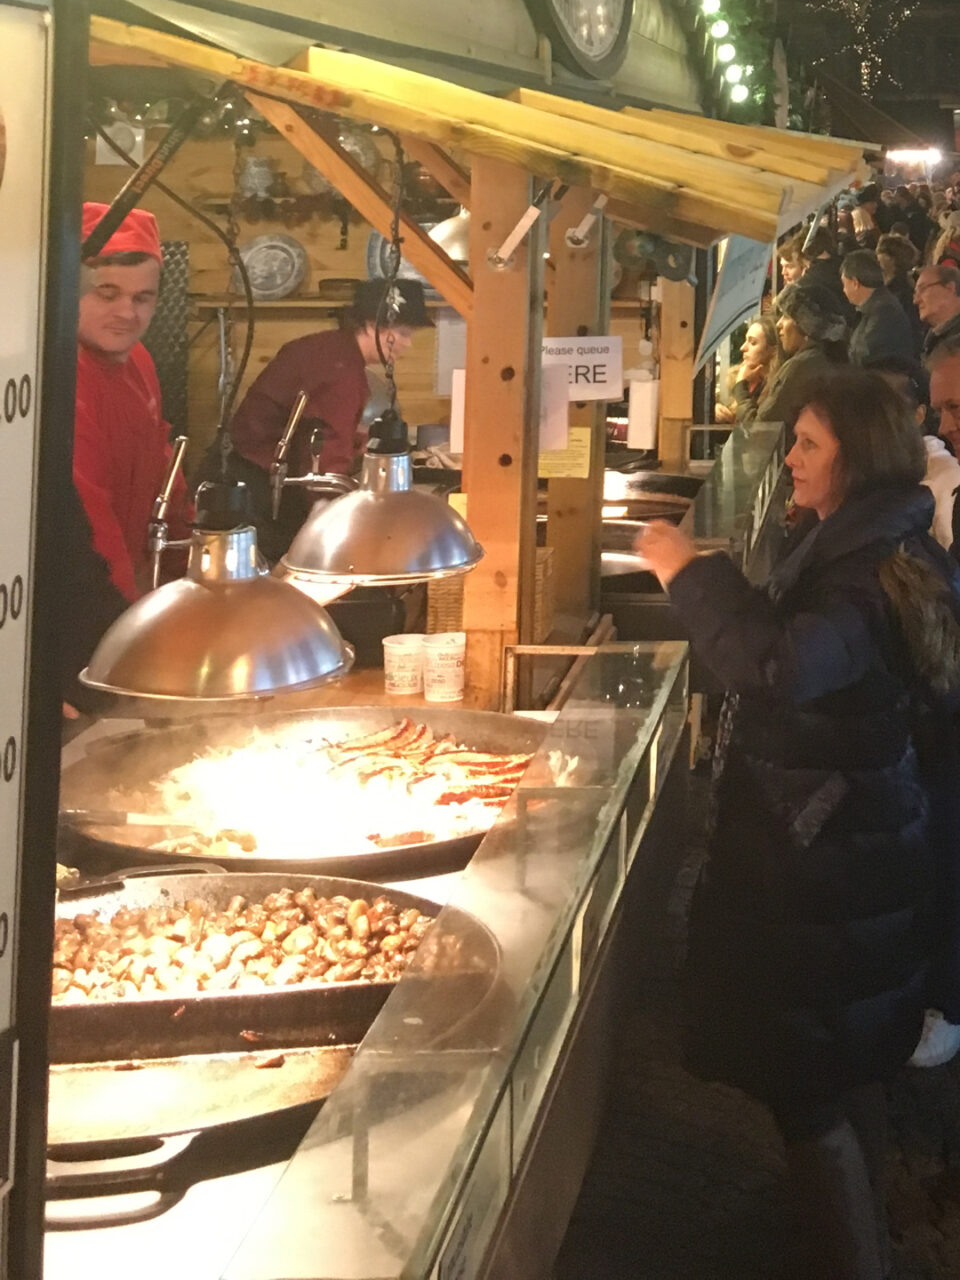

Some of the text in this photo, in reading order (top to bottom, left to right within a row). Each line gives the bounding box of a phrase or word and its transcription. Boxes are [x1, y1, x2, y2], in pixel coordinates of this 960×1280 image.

[577, 345, 610, 356] queue
[0, 373, 31, 424] 00
[0, 735, 16, 783] 0
